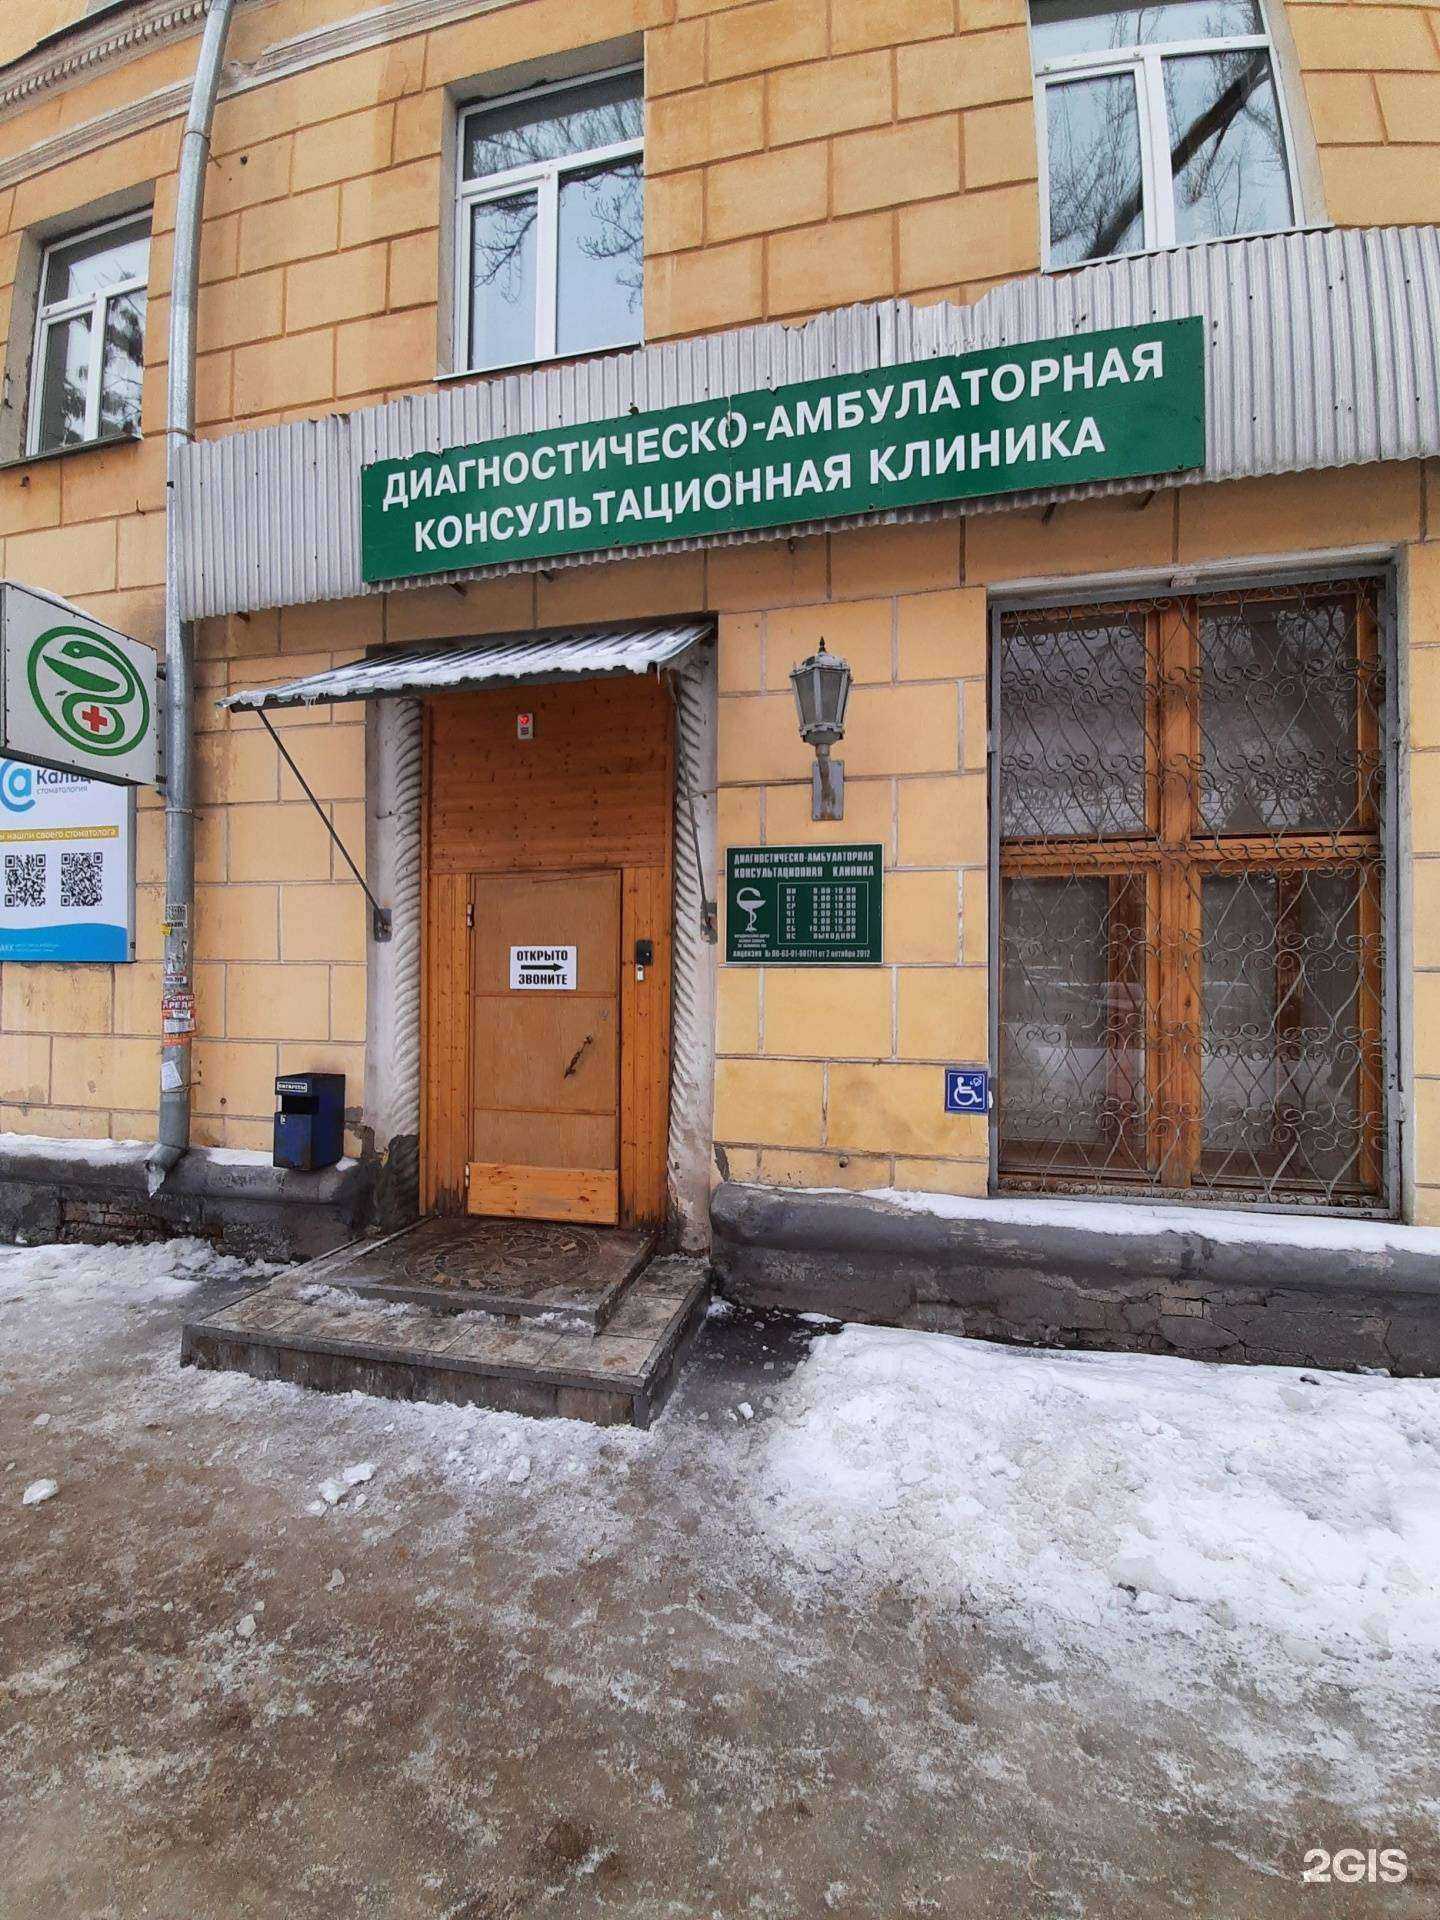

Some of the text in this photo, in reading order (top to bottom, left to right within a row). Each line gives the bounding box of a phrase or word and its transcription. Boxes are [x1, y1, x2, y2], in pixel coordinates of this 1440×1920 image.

[382, 341, 1164, 511] ДИАГНОСТИЧЕСКО-АМБУЛАТОРНАЯ
[415, 416, 1106, 552] КОНСУЛЬТАЦИОННАЯ КЛИНИКА
[734, 851, 874, 865] ДИАГНОСТИЧЕСКО-АМБУЛАТОРНАЯ
[734, 865, 874, 879] КОНСУЛЬТАЦИОННАЯ КЛИНИКА
[517, 950, 568, 961] ОТКРЫТО
[518, 974, 568, 985] ЗВОНИТЕ
